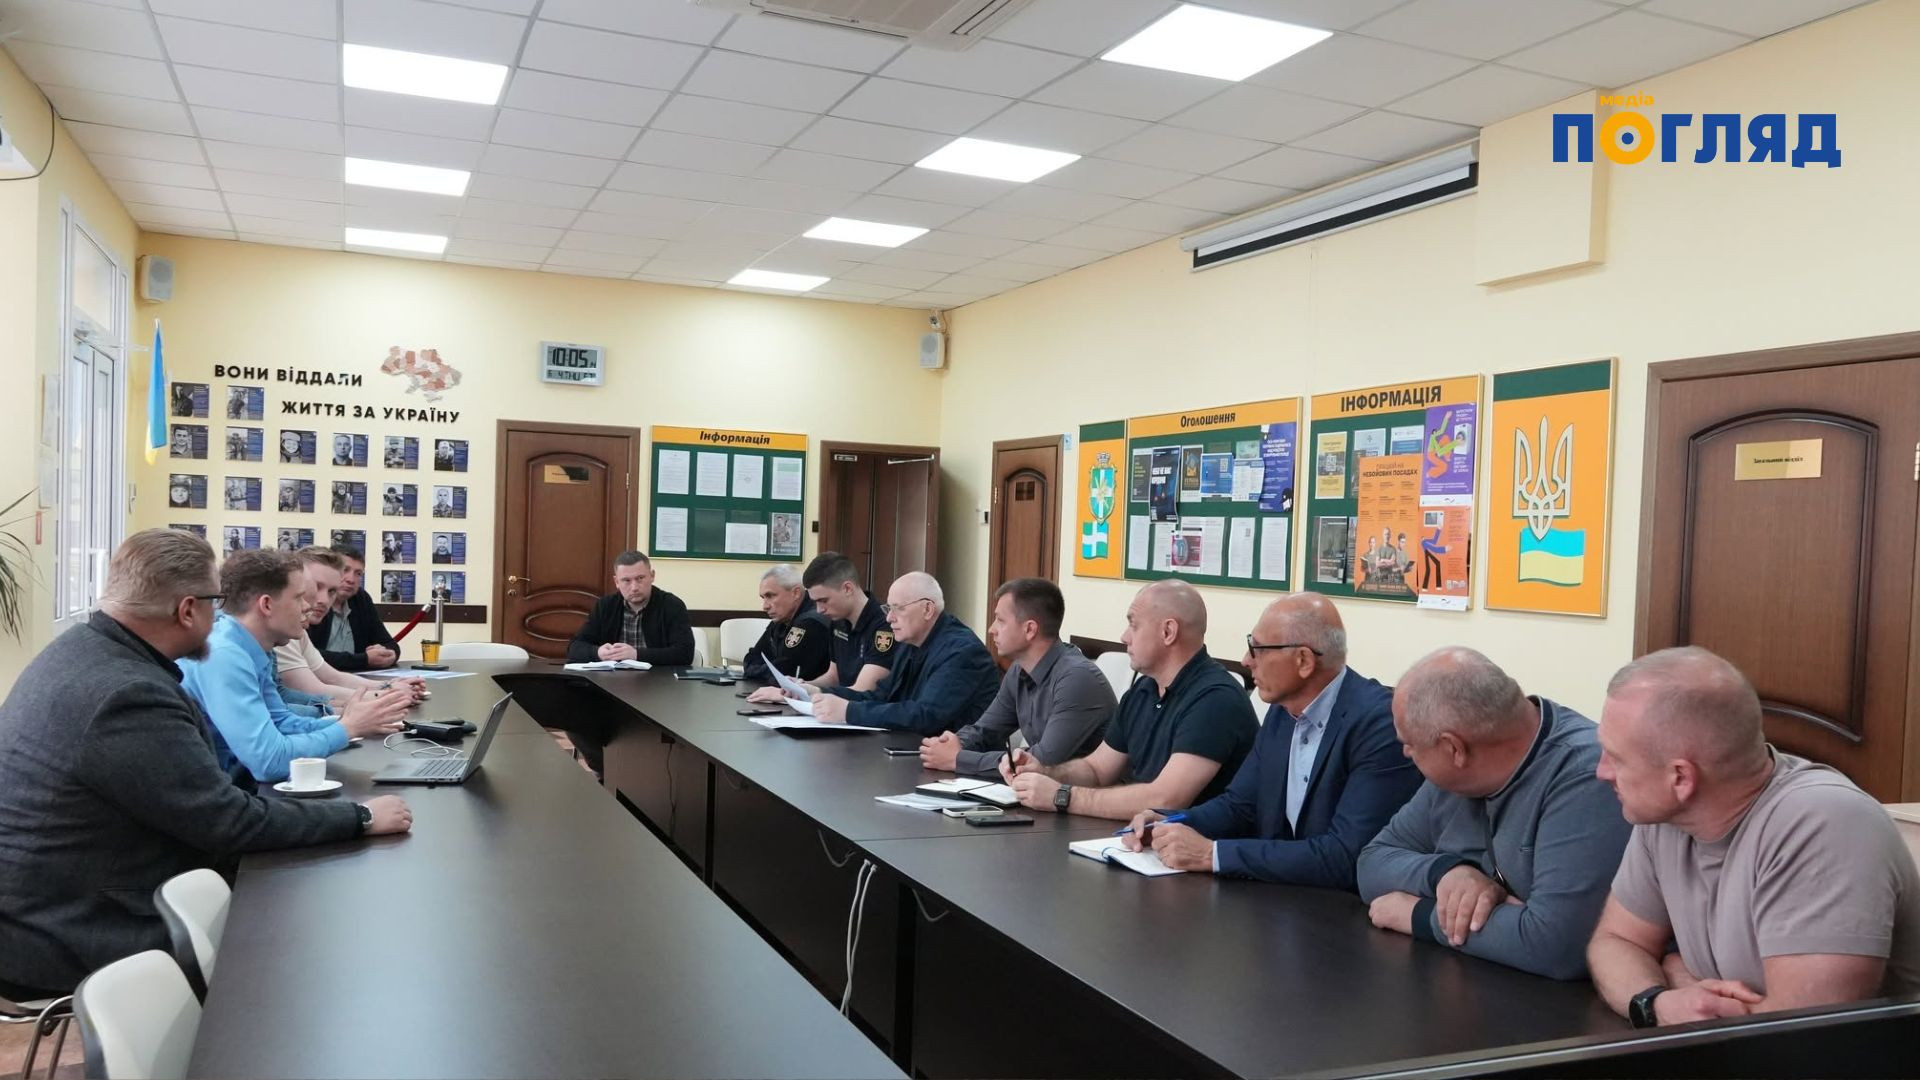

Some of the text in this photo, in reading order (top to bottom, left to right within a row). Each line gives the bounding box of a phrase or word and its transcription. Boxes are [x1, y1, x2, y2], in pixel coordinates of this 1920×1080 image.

[214, 364, 269, 380] ВОНИ
[1341, 385, 1442, 412] ІНФОРМАЦІЯ
[281, 400, 346, 417] ЖИТТЯ
[353, 405, 376, 419] ЗА
[383, 407, 460, 423] УКРАЇНУ
[1180, 412, 1236, 428] Оголошення
[699, 430, 771, 446] Інформація
